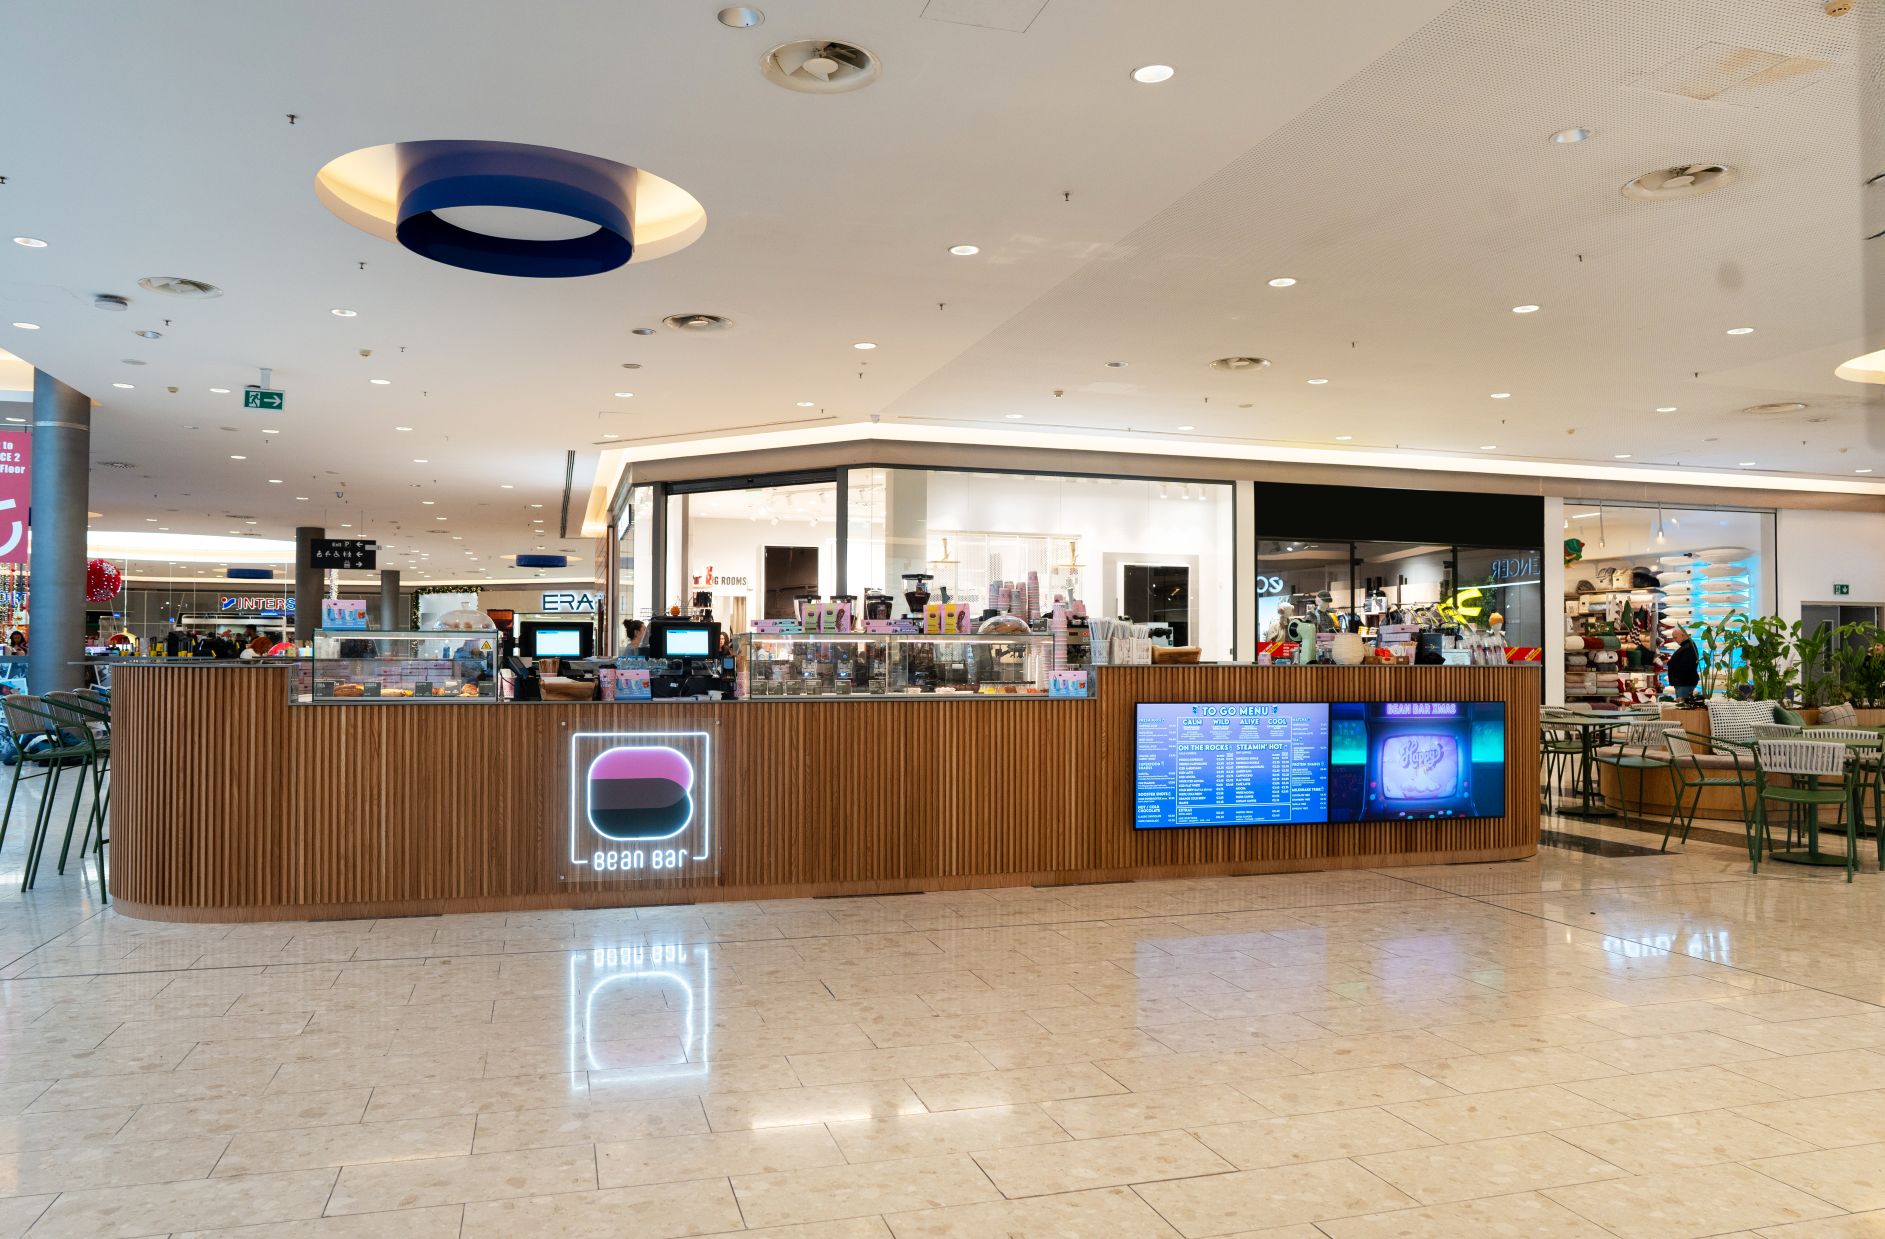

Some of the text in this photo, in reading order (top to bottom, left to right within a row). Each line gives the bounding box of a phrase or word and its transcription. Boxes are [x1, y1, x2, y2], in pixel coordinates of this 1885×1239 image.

[3, 441, 14, 450] to
[14, 453, 21, 462] 2
[0, 464, 26, 474] Floor
[721, 576, 747, 586] ROOMS
[237, 597, 297, 611] INTERS
[1202, 706, 1269, 716] TO GO MENU
[1387, 703, 1457, 715] BEAN BAR XMAS
[1240, 718, 1260, 726] ALIVE
[1236, 743, 1268, 751] STEAMIN'
